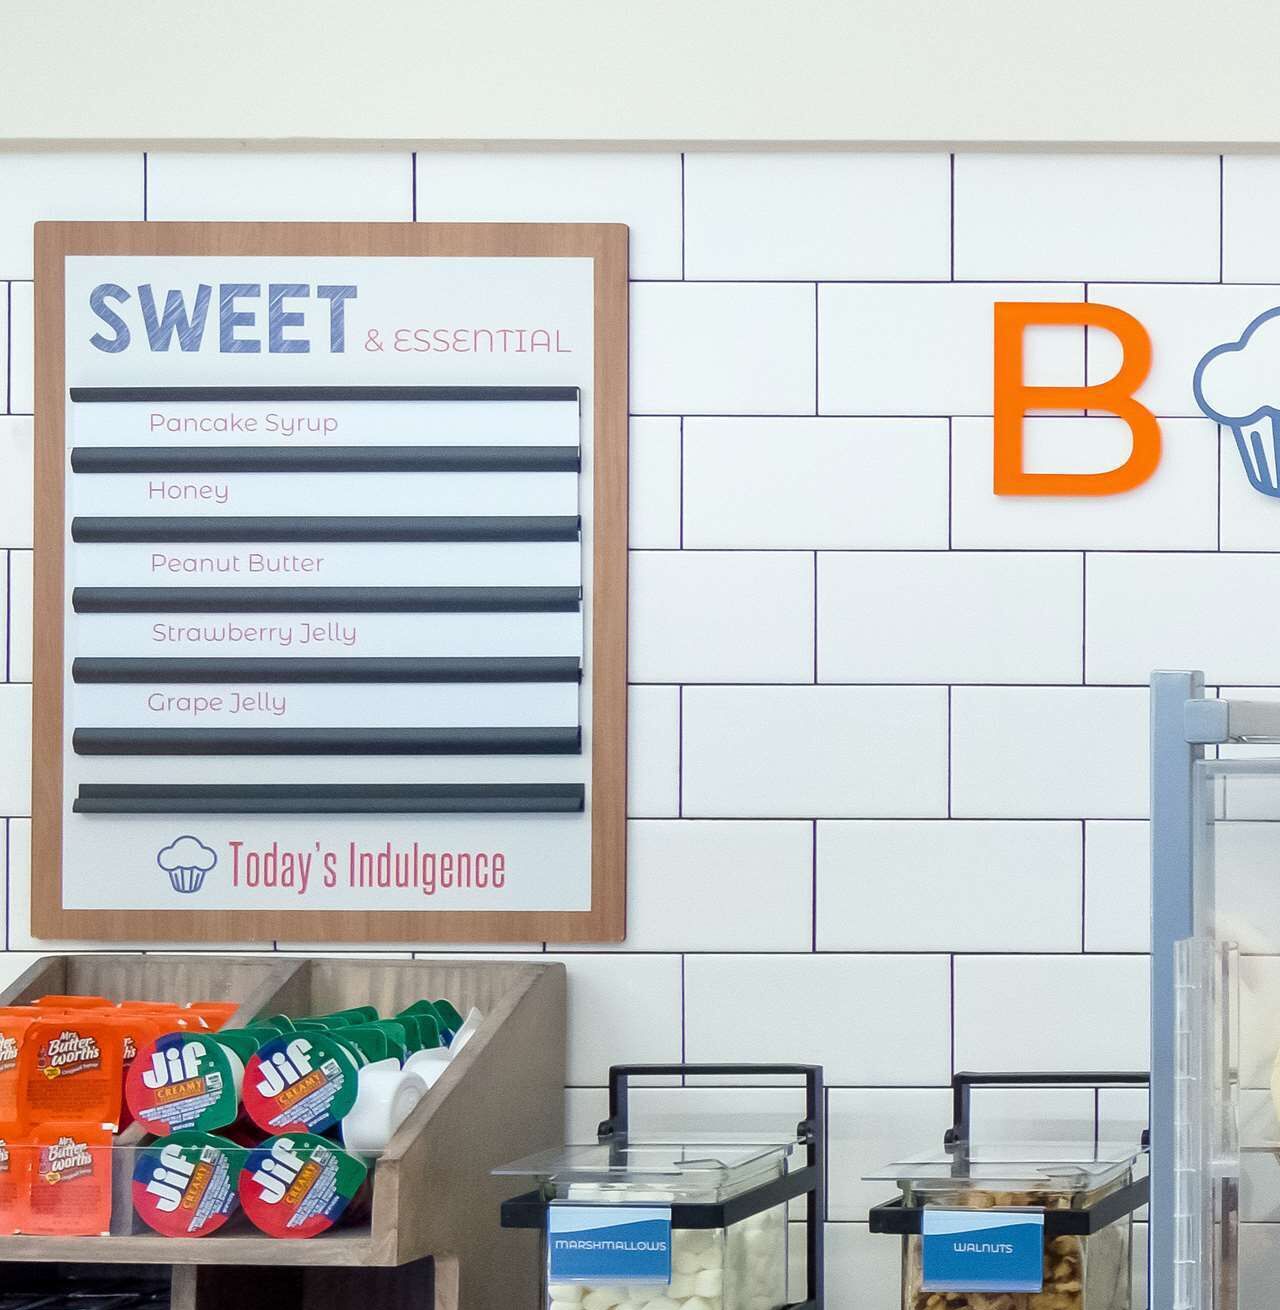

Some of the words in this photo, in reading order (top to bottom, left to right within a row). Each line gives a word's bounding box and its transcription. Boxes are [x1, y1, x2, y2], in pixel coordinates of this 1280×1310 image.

[89, 283, 358, 353] SWEET
[364, 328, 385, 352] &
[394, 328, 573, 353] ESSENTIAL
[150, 413, 258, 432] Pancake
[265, 413, 338, 436] Syrup
[149, 481, 229, 504] Honey
[152, 553, 241, 572] Peanut
[249, 553, 324, 573] Butter
[152, 622, 292, 646] Strawberry
[300, 622, 357, 646] Jelly
[148, 692, 223, 716] Grape
[229, 691, 287, 716] Jelly
[229, 841, 338, 895] Today's
[349, 842, 506, 896] Indulgence
[142, 1041, 207, 1089] Jif
[256, 1039, 313, 1098] Jif
[145, 1144, 195, 1212] Jif
[251, 1138, 304, 1204] Jif
[555, 1239, 668, 1251] MARSHMALLOWS
[953, 1242, 1014, 1254] WALNUTS
